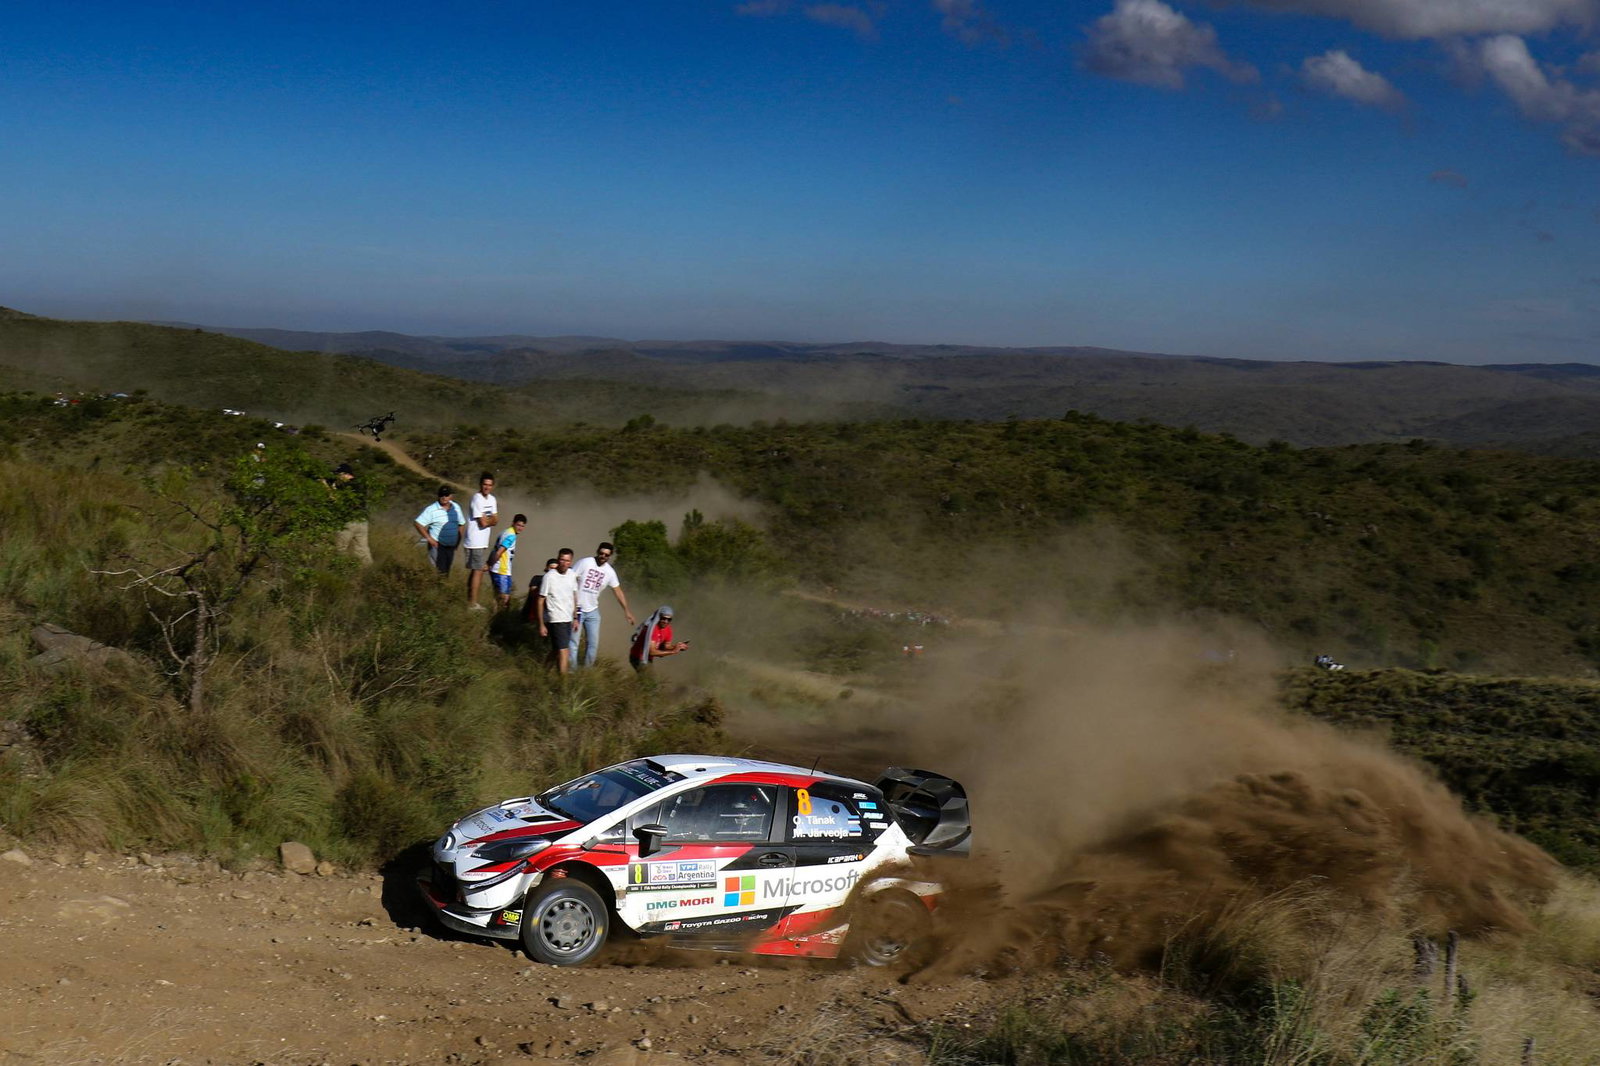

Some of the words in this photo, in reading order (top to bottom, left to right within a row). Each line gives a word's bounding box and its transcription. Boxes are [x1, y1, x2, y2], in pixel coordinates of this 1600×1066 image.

[797, 788, 812, 815] 8
[805, 815, 835, 825] Tänak
[808, 828, 848, 838] Järveoja
[634, 864, 642, 884] 8
[678, 870, 714, 881] Argentina
[764, 869, 859, 898] Microsoft
[646, 901, 677, 910] DMG
[680, 897, 714, 907] MORI
[503, 912, 519, 921] OMP
[682, 921, 712, 929] TOYOTA
[714, 917, 741, 925] GAZOO
